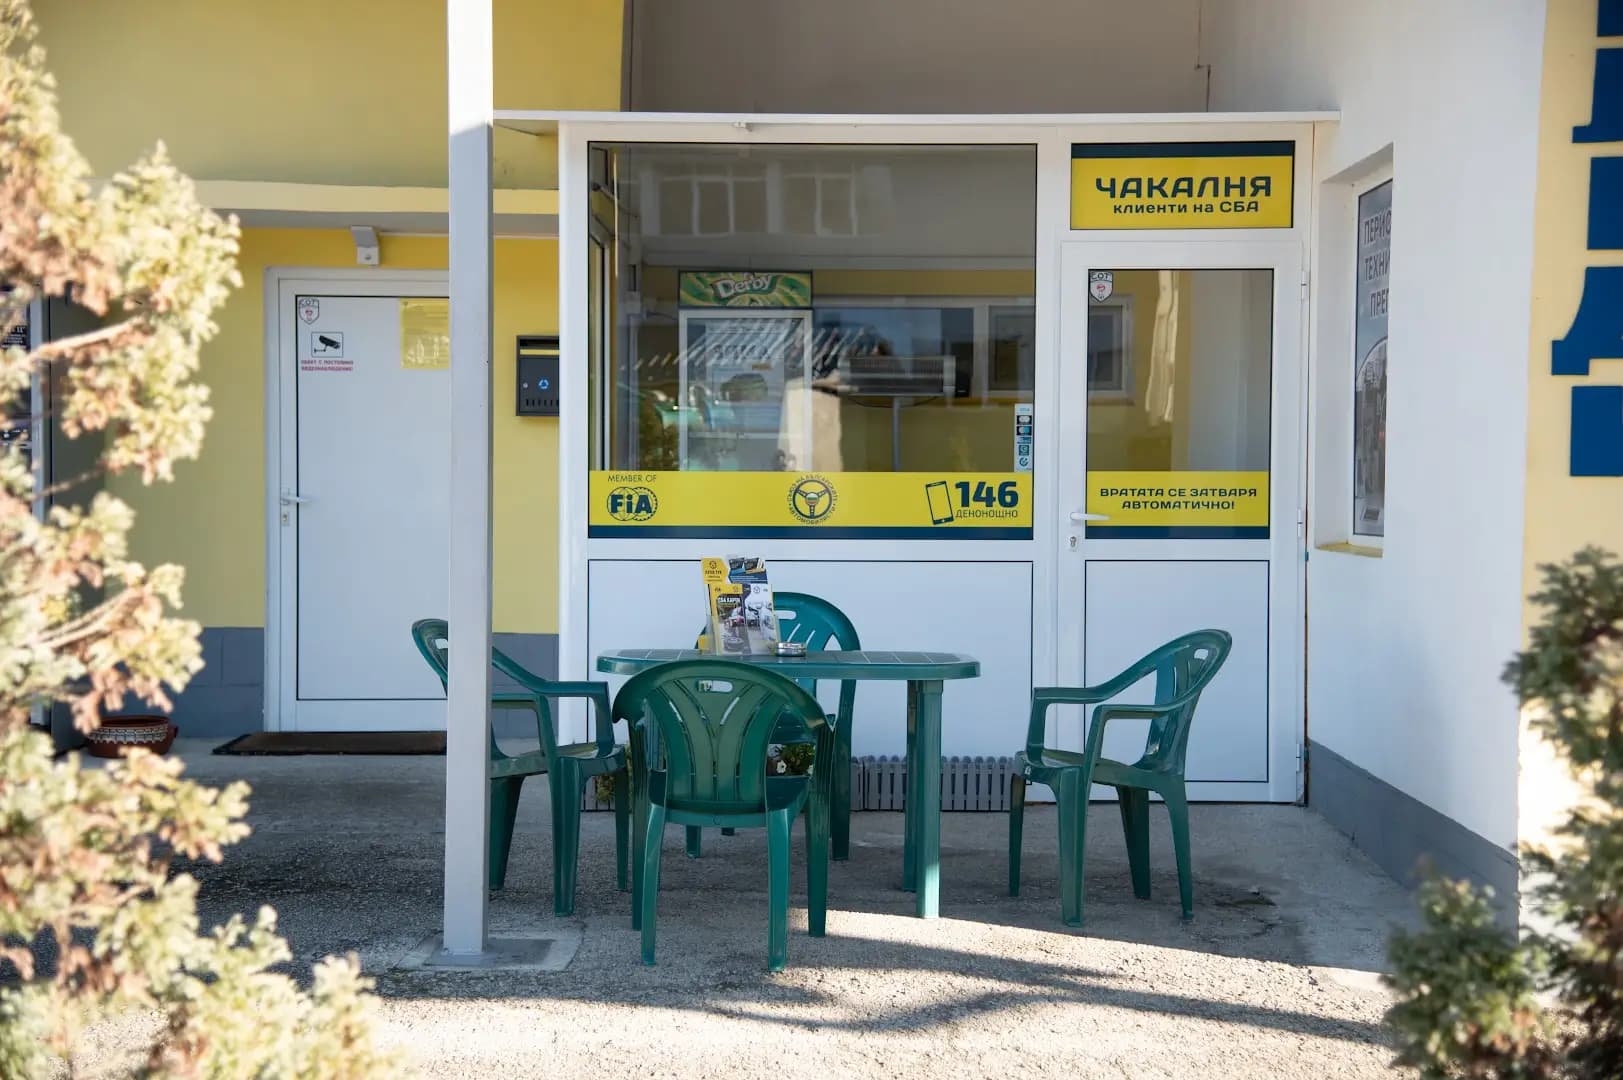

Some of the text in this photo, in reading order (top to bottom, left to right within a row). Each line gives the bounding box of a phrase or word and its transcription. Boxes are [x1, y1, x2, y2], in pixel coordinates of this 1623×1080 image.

[1096, 176, 1271, 199] ЧАКАЛНЯ
[1113, 201, 1259, 214] клиенти на СБА
[716, 274, 773, 299] Derby
[607, 474, 657, 482] MEMBER OF
[955, 481, 1019, 508] 146
[1100, 488, 1257, 497] ВРАТАТА СЕ ЗАТВАРЯ
[1122, 500, 1235, 510] АВТОМАТИЧНО!
[955, 509, 1018, 519] ДЕНОНОЩНО
